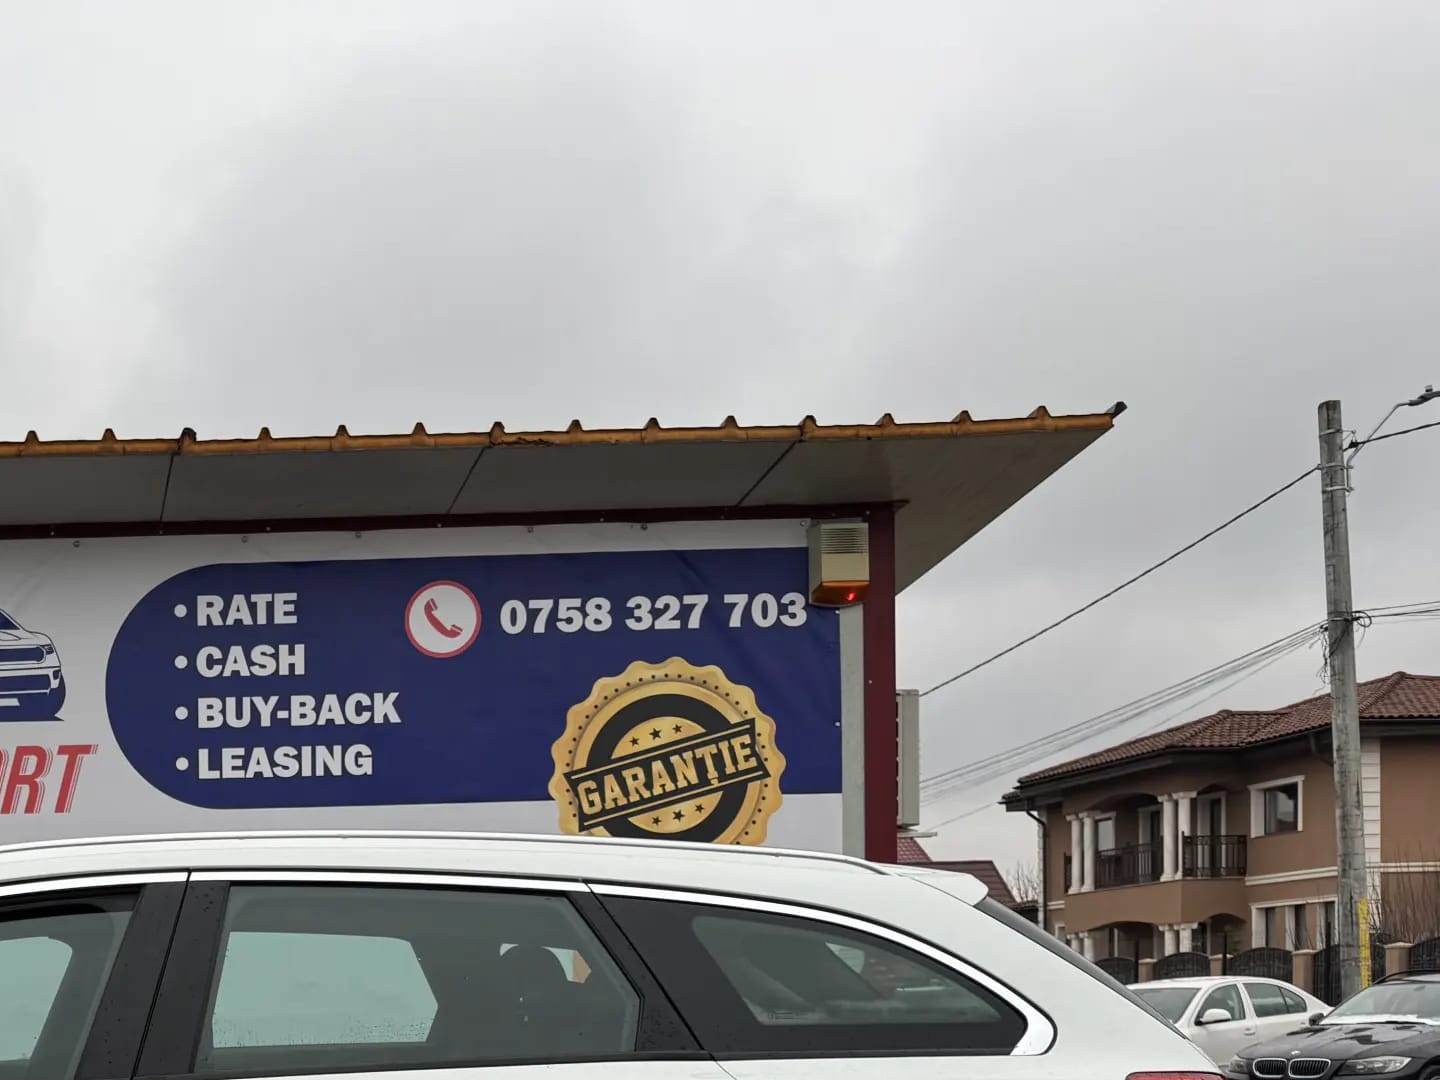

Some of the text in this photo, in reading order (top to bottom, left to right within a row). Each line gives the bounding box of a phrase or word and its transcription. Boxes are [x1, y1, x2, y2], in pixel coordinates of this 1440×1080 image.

[196, 593, 298, 627] RATE
[500, 591, 808, 634] 0758 327 703
[196, 643, 306, 678] CASH
[197, 691, 401, 729] BUY-BACK
[197, 744, 373, 780] LEASING
